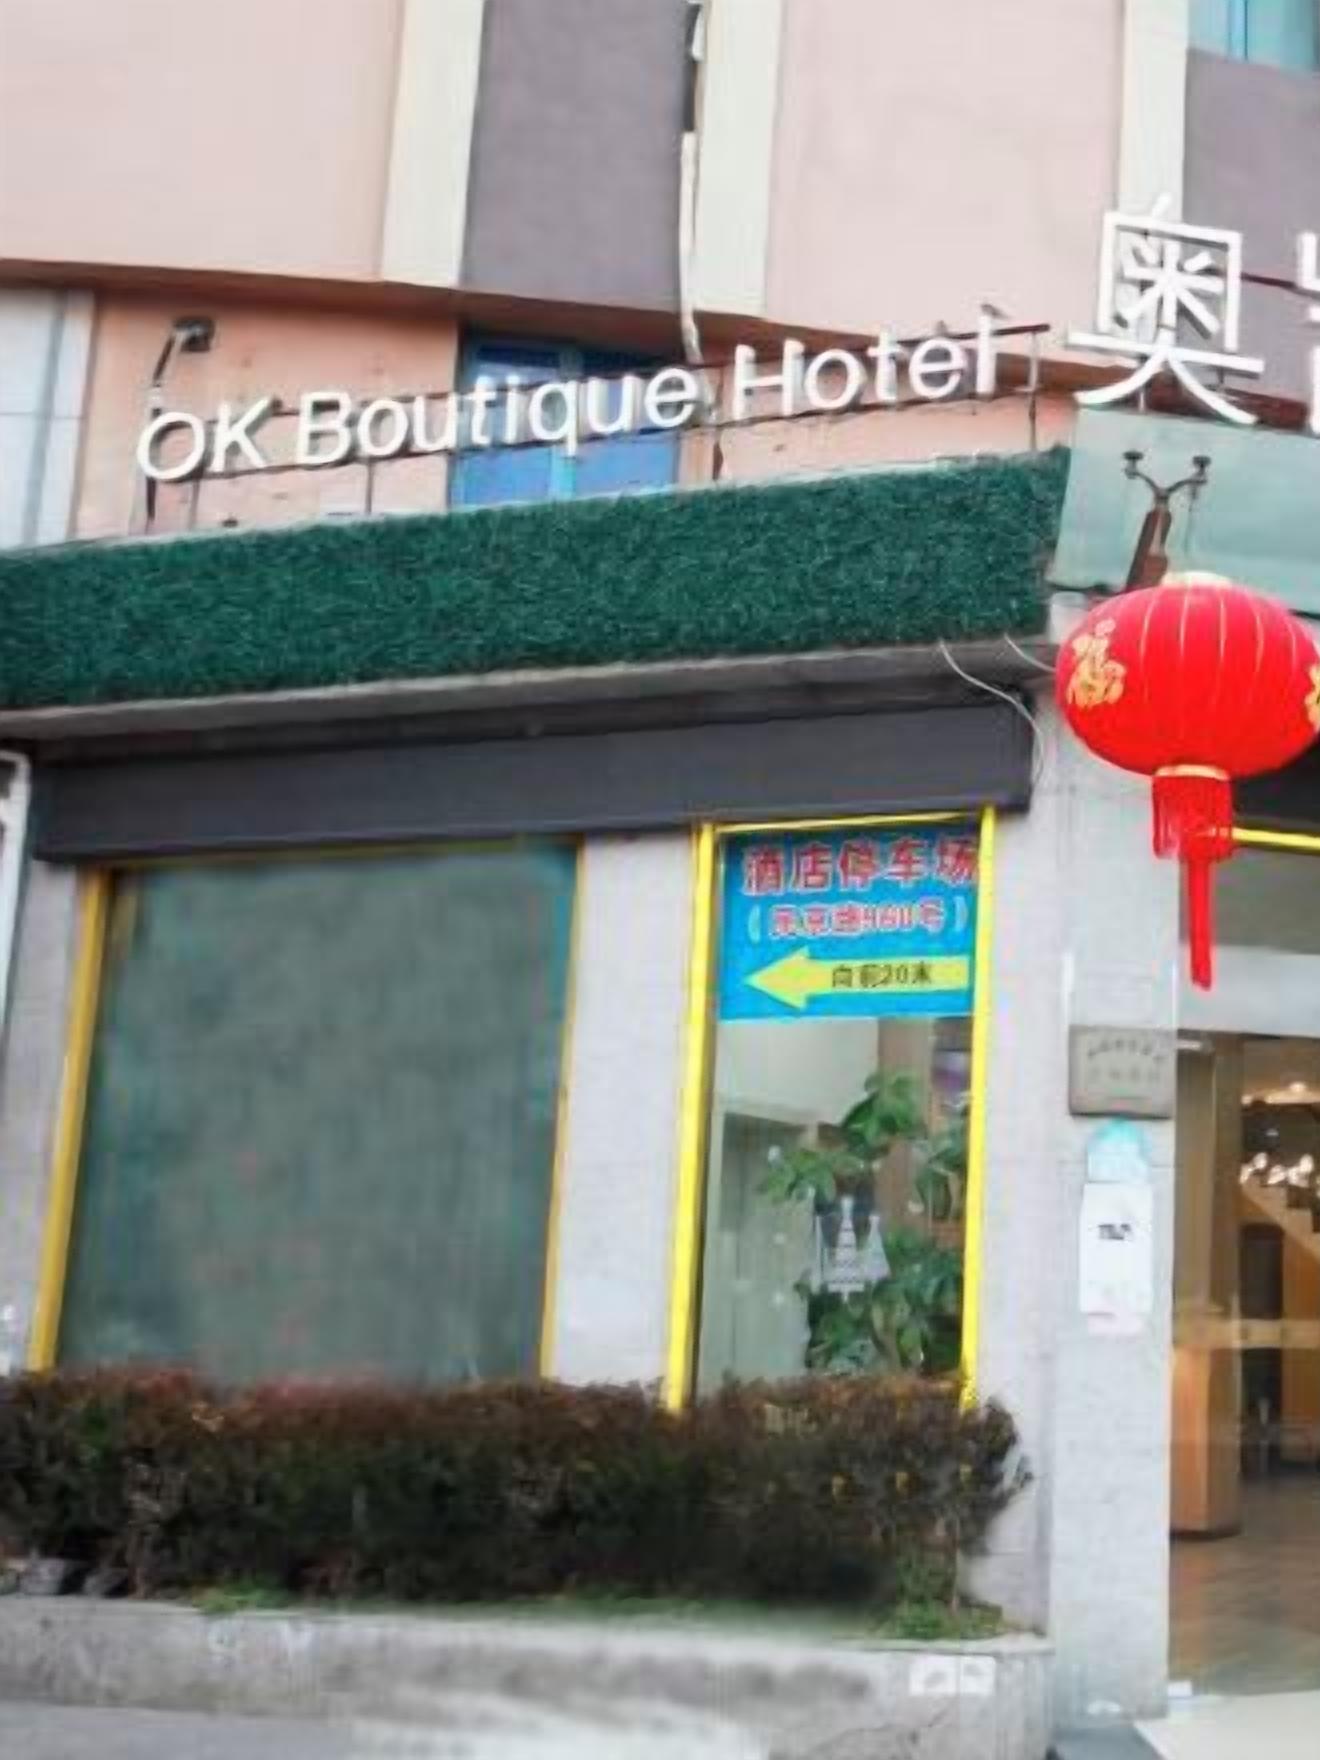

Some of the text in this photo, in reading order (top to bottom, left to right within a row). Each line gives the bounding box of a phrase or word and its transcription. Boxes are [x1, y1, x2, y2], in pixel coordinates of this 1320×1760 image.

[137, 315, 998, 483] OK Boutique Hotel
